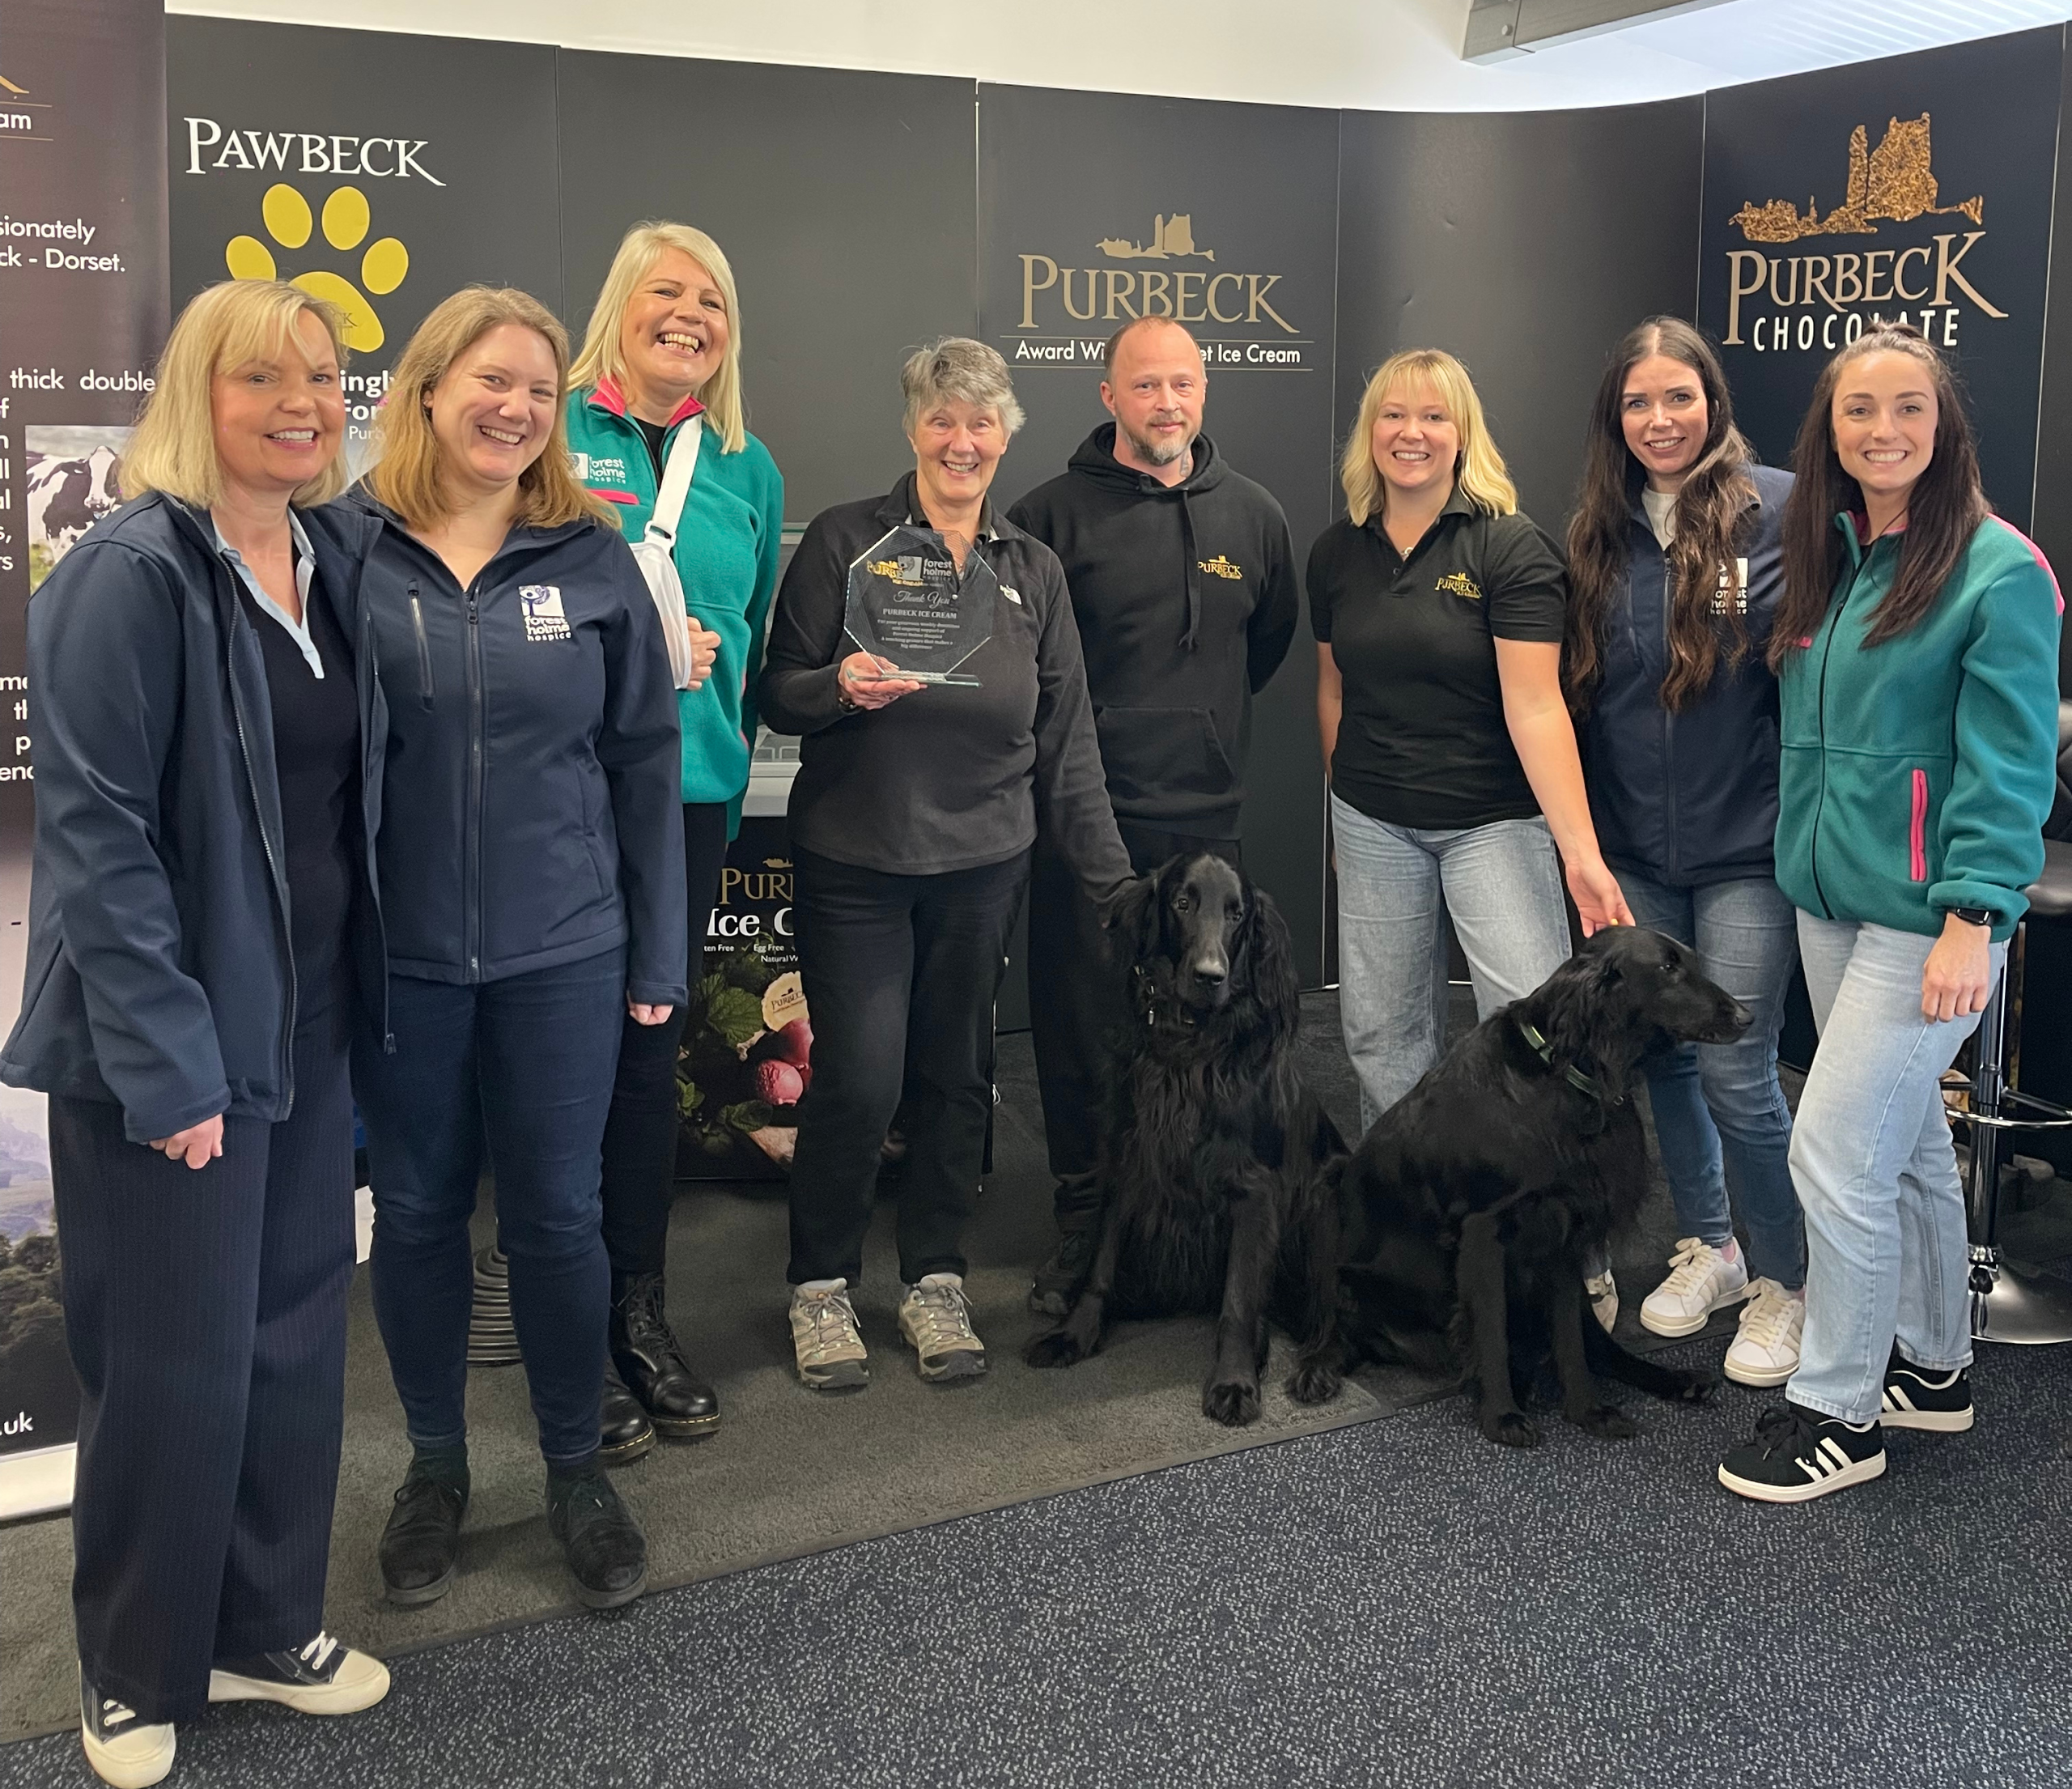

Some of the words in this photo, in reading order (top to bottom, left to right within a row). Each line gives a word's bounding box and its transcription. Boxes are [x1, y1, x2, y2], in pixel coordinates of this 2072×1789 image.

[184, 117, 447, 186] PAWBECK
[45, 248, 125, 272] Dorset.
[1017, 254, 1300, 333] PURBECK
[1722, 232, 2009, 345] PURBECK
[1015, 339, 1075, 360] Award
[1218, 343, 1242, 363] Ice
[1246, 344, 1301, 363] Cream
[10, 368, 65, 389] thick
[80, 369, 156, 392] double
[340, 369, 395, 398] ingl
[589, 456, 626, 470] forest
[589, 465, 626, 479] holme
[923, 558, 953, 569] forest
[923, 567, 953, 577] holme
[1434, 577, 1483, 597] PURBECK
[893, 590, 925, 603] Thank
[927, 591, 950, 609] You
[524, 615, 568, 626] forest
[882, 608, 917, 617] PURBECK
[931, 611, 957, 619] CREAM
[525, 623, 571, 635] holme
[527, 631, 571, 642] hospice
[706, 907, 760, 937] Ice
[717, 943, 735, 952] Free
[753, 943, 766, 954] Egg
[767, 943, 785, 952] Free
[761, 955, 788, 963] Natural
